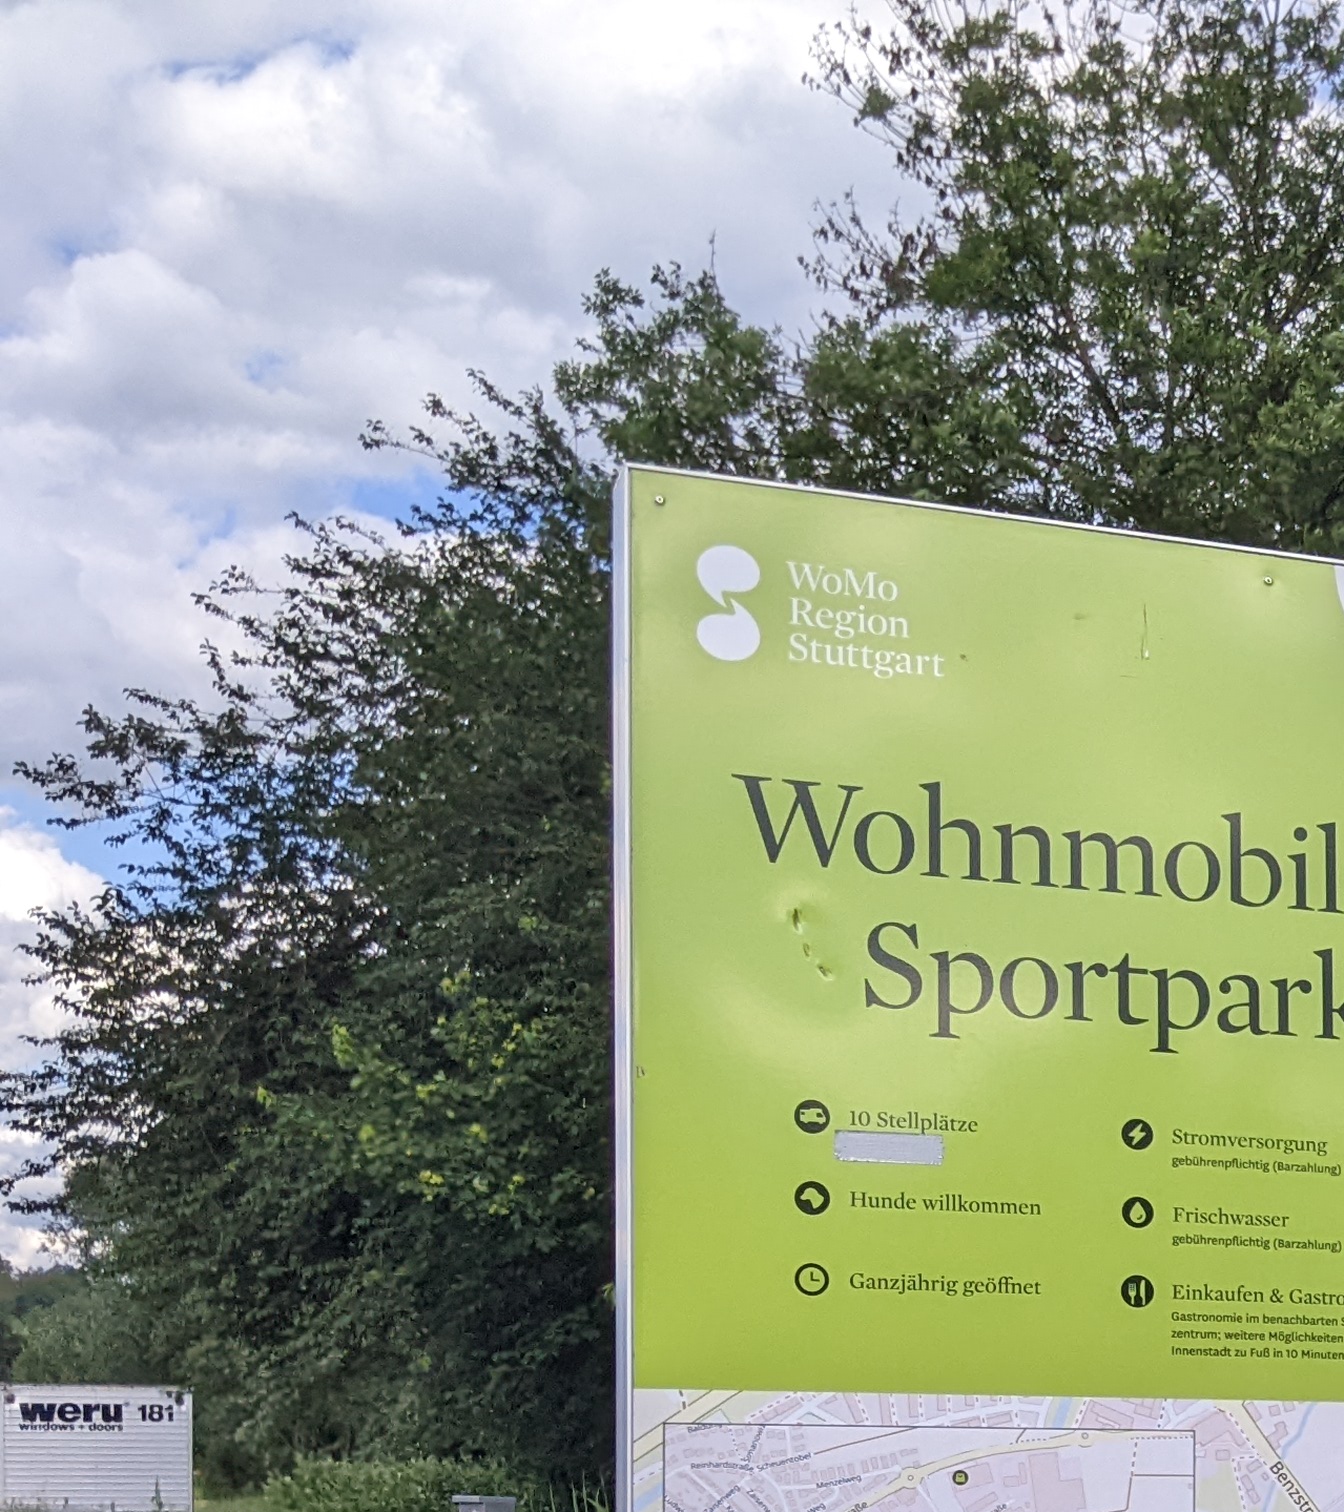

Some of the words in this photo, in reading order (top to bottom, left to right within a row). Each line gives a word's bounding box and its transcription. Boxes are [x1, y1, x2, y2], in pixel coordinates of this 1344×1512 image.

[786, 561, 898, 601] WoMo
[789, 597, 910, 639] Region
[788, 632, 945, 679] Stuttgart
[850, 1110, 870, 1126] 10
[877, 1112, 978, 1134] Stellplätze
[1172, 1128, 1328, 1156] Stromversorgung
[1172, 1156, 1270, 1173] gebührenpflichtig
[1273, 1160, 1341, 1176] (Barzahlung)
[850, 1191, 916, 1210] Hunde
[922, 1194, 1041, 1216] willkommen
[1172, 1207, 1289, 1228] Frischwasser
[850, 1272, 958, 1296] Ganzjährig
[962, 1276, 1041, 1296] geöffnet
[1172, 1284, 1264, 1302] Einkaufen
[1270, 1288, 1283, 1303] &
[1172, 1312, 1242, 1323] Gastronomie
[1246, 1314, 1259, 1324] im
[1262, 1314, 1338, 1327] benachbarten
[19, 1403, 123, 1423] weru
[138, 1405, 174, 1422] 181
[19, 1423, 75, 1431] windows
[89, 1423, 123, 1432] doors
